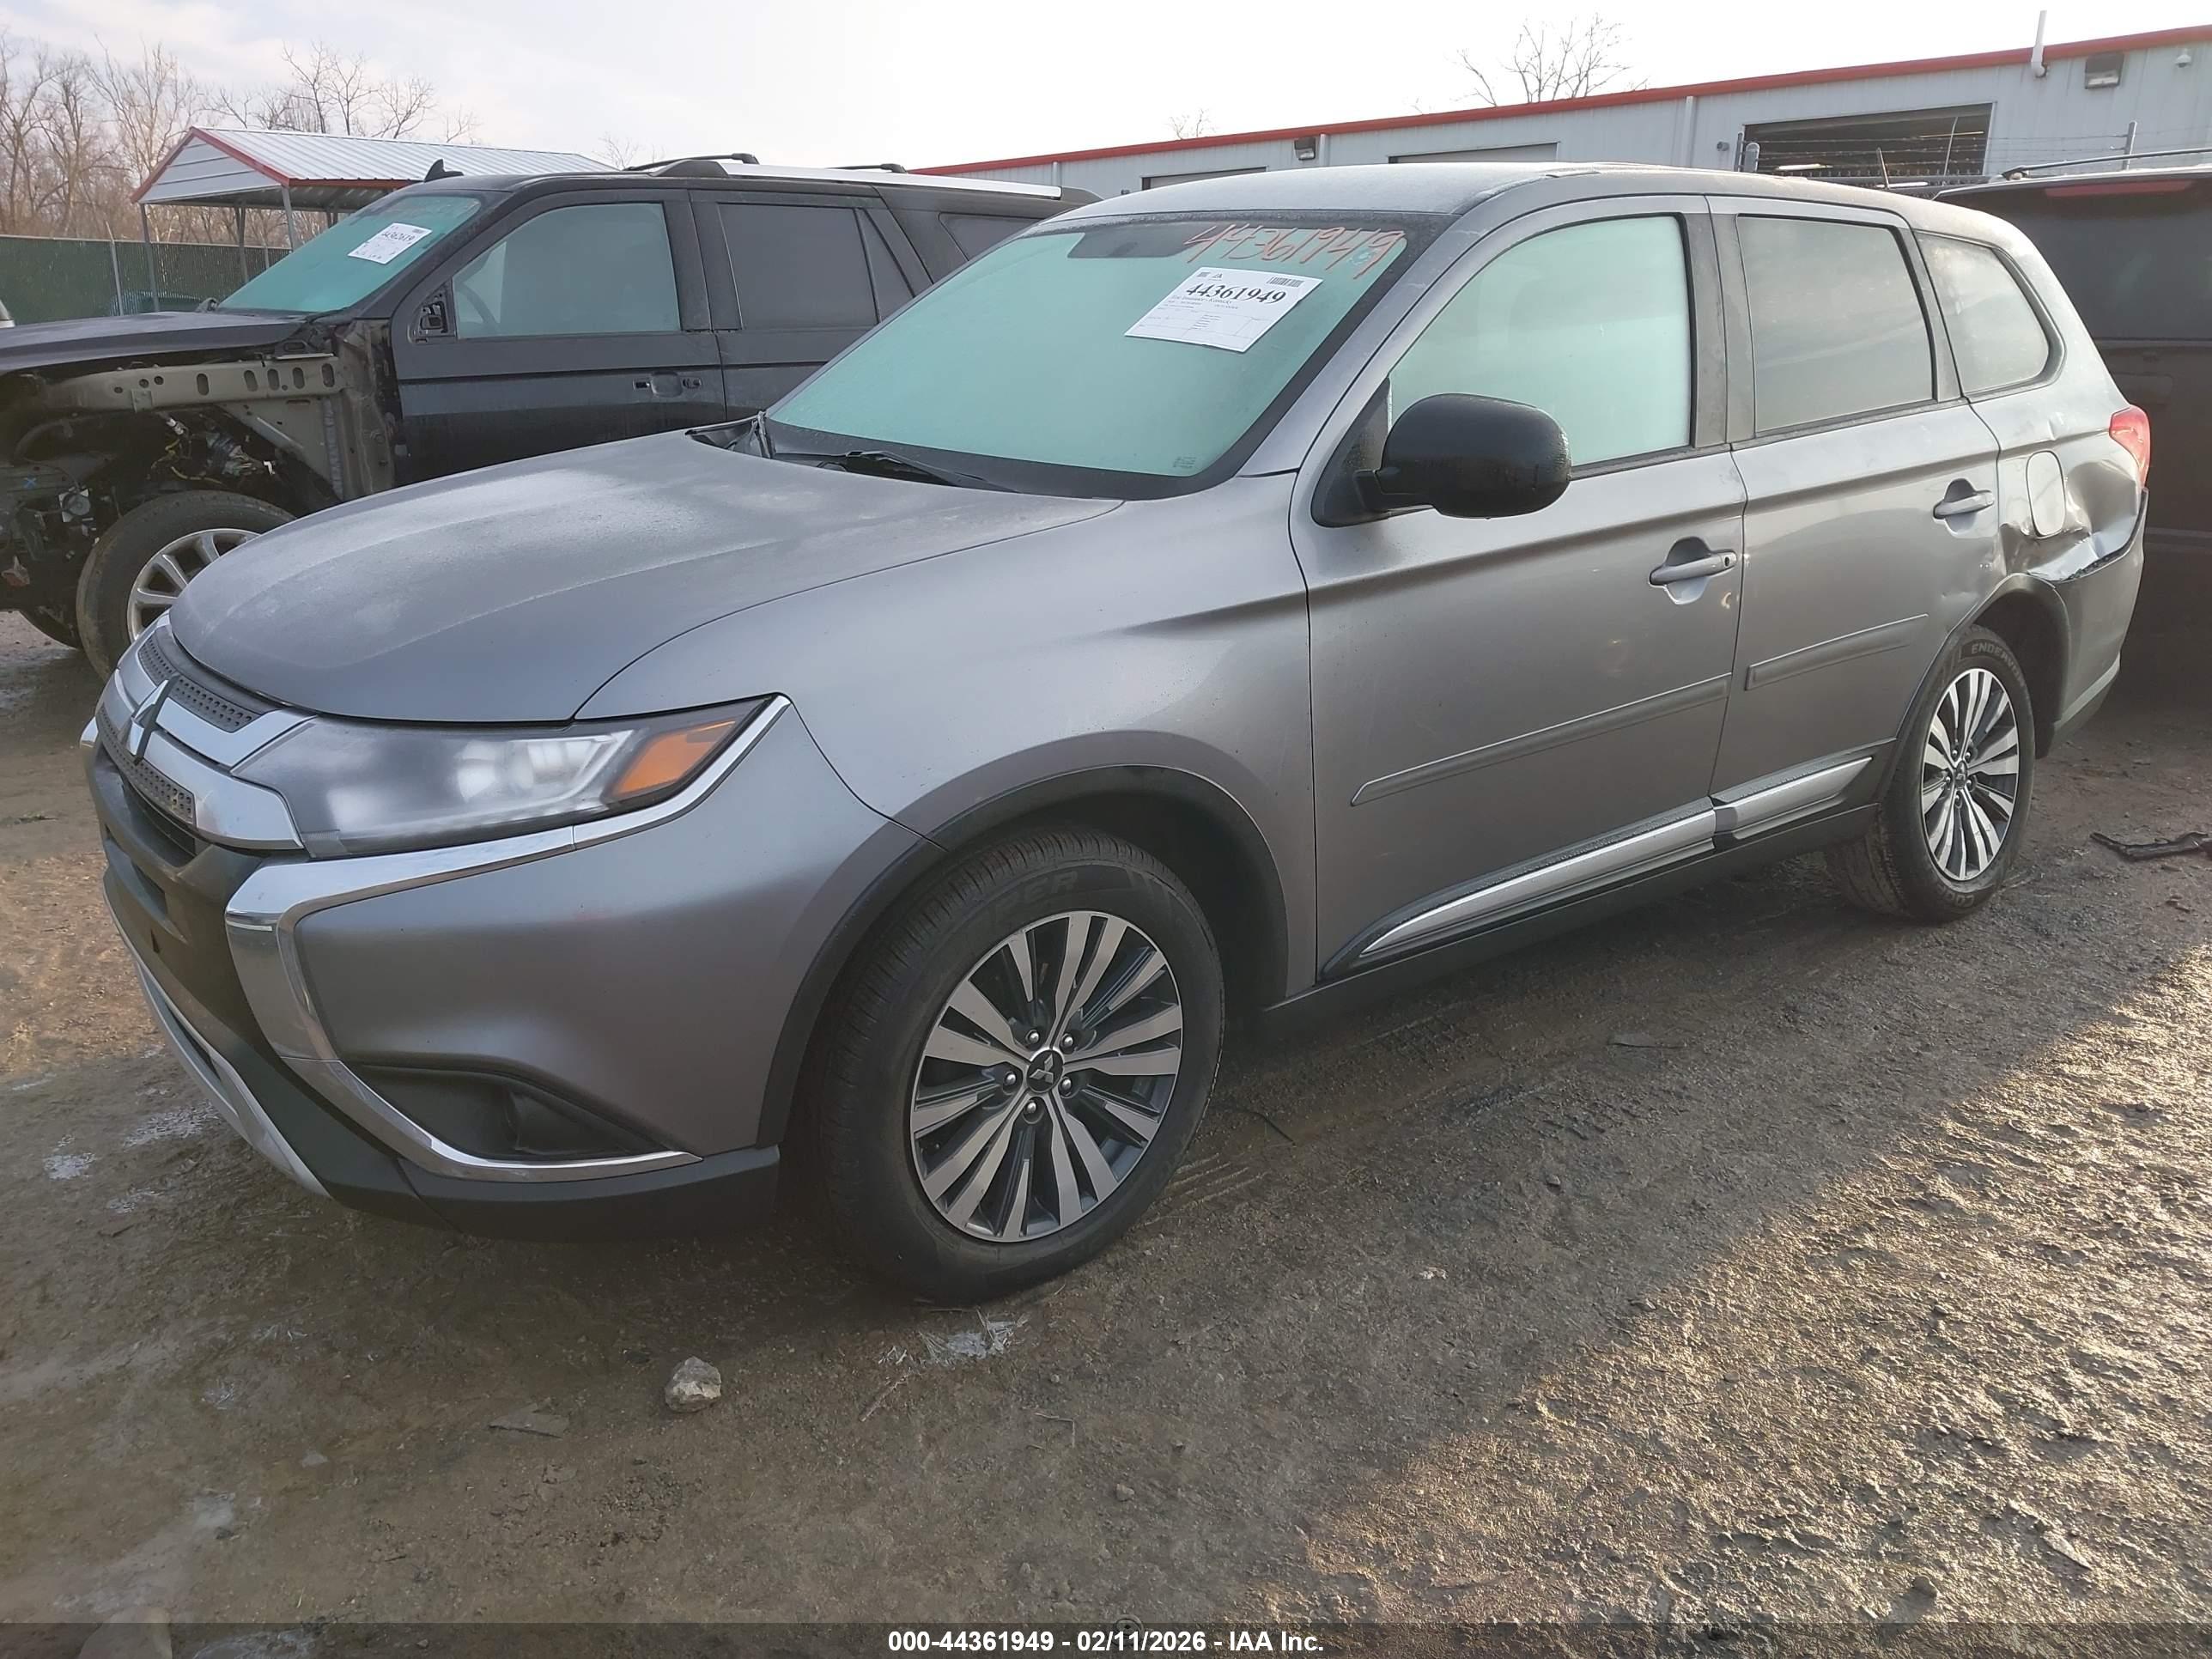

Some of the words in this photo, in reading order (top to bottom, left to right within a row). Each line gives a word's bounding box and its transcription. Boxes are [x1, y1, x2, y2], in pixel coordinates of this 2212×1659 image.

[1183, 222, 1406, 279] 44361949
[1186, 283, 1287, 304] 44361949
[1972, 641, 2026, 688] ENDEAVOR
